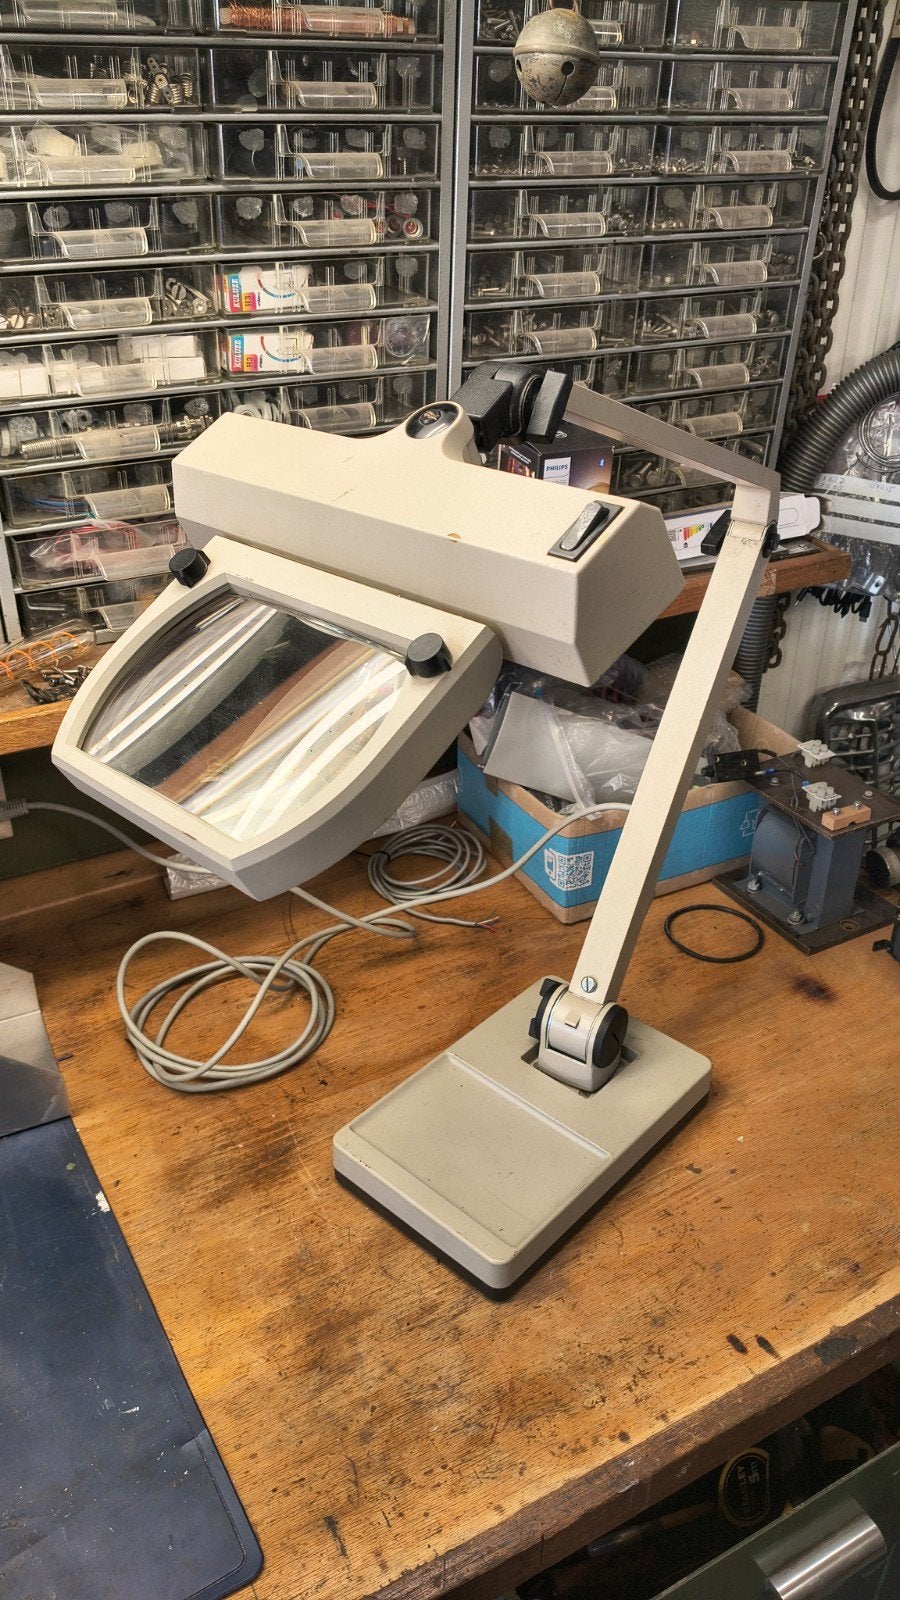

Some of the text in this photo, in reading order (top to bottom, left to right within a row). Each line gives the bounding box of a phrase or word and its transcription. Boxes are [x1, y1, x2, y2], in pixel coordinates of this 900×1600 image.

[231, 278, 240, 308] KULUZE
[244, 295, 251, 307] H3
[234, 339, 242, 368] KULUZE
[246, 356, 253, 367] H3
